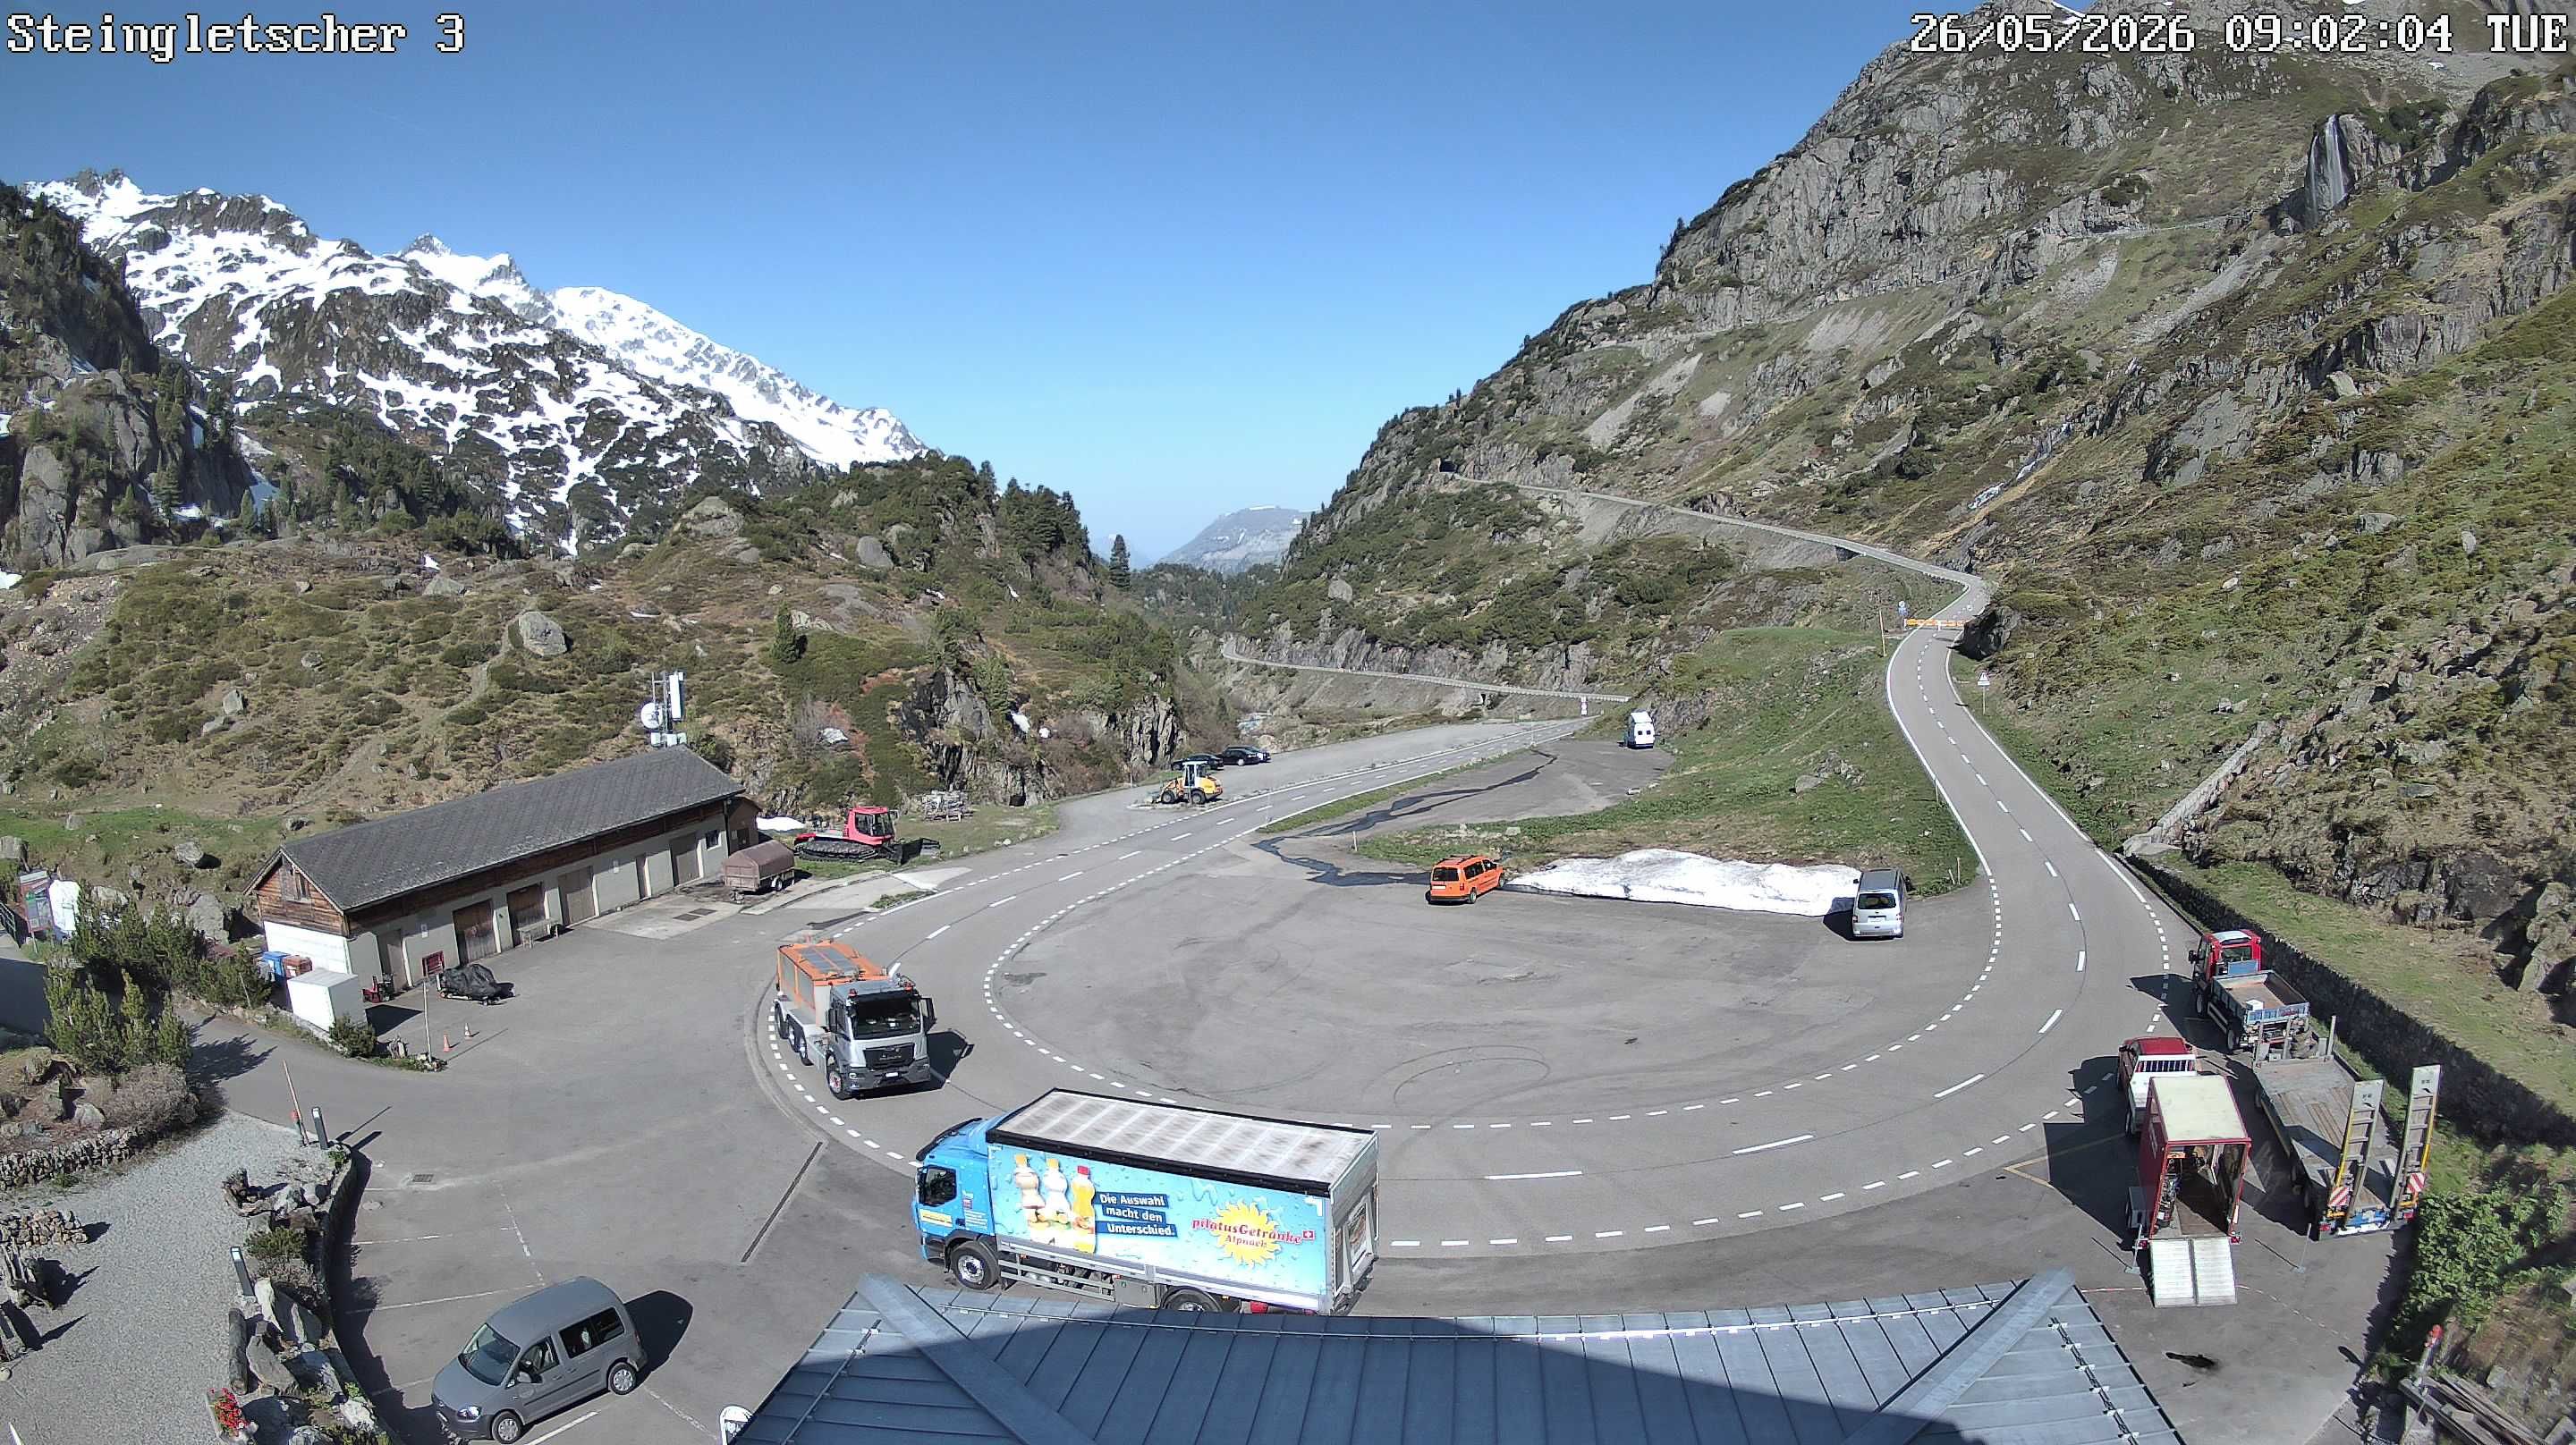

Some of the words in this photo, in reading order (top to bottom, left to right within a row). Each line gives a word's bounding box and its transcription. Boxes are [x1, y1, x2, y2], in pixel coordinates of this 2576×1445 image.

[1099, 1194, 1117, 1204] Die
[1120, 1196, 1165, 1206] Auswahl
[1106, 1207, 1140, 1220] macht
[1141, 1212, 1163, 1222] den
[1106, 1222, 1175, 1236] Unterschied.
